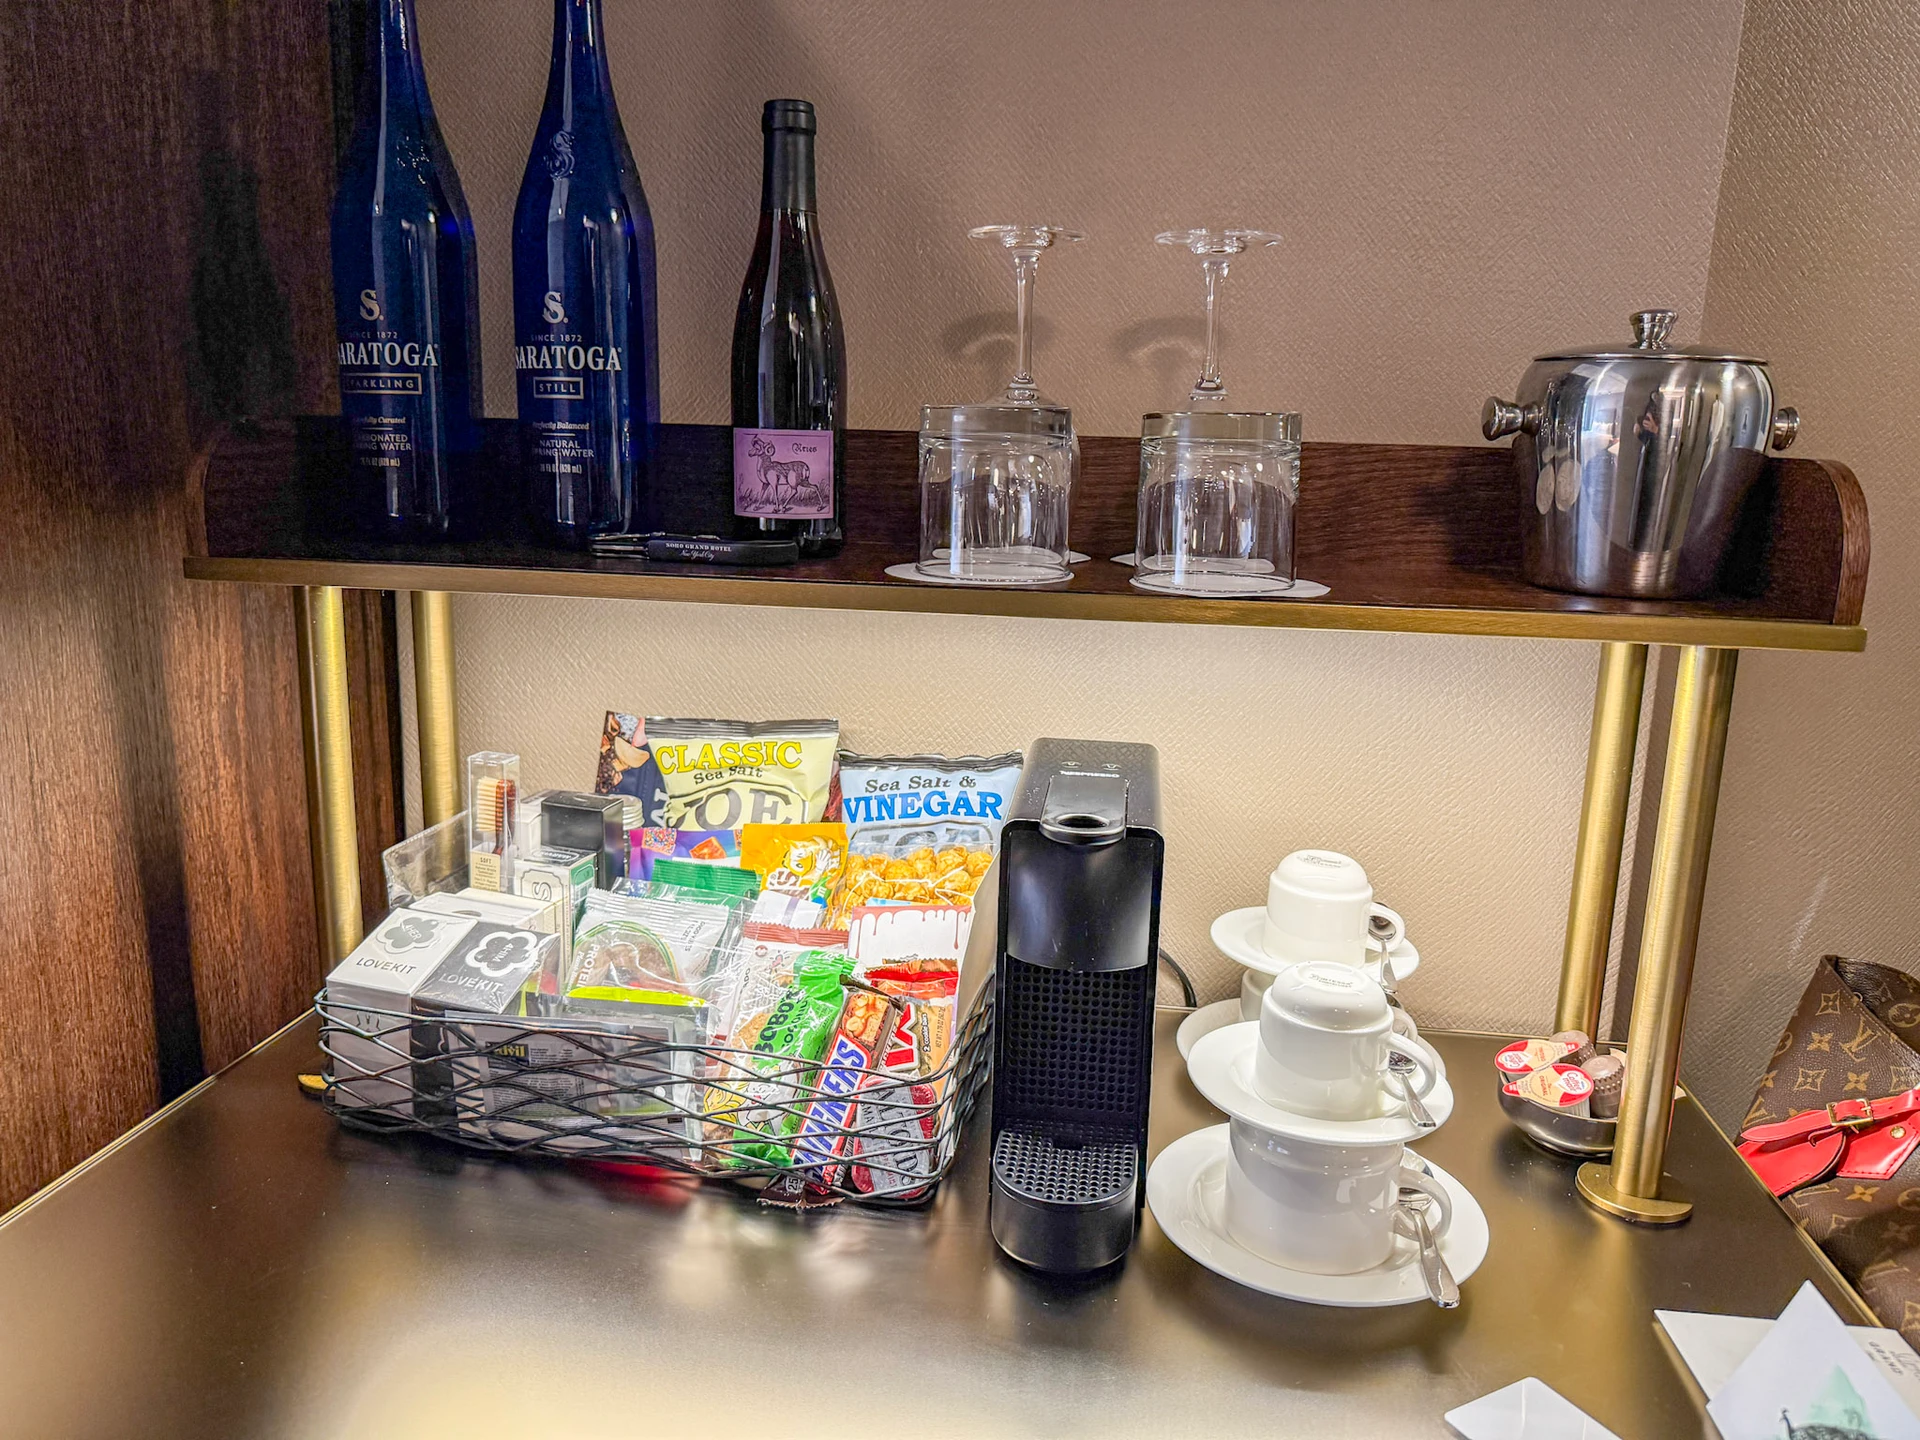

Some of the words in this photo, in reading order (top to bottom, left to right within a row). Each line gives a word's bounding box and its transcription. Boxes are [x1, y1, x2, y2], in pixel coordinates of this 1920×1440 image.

[338, 342, 438, 366] ARATOGA
[540, 383, 576, 393] STILL
[380, 443, 412, 451] WATER
[540, 440, 580, 449] NATURAL
[562, 449, 594, 458] WATER
[655, 742, 803, 775] CLASSIC
[694, 770, 724, 785] Sea
[728, 766, 763, 778] Salt
[865, 779, 900, 793] Sea
[908, 776, 952, 789] Salt
[958, 776, 976, 788] &
[843, 790, 1003, 824] VINEGAR
[356, 957, 417, 974] LOVEKIT
[576, 943, 600, 988] PROTEI
[438, 973, 504, 992] LOVEKIT
[922, 1026, 930, 1045] cookie
[922, 1044, 930, 1052] 2
